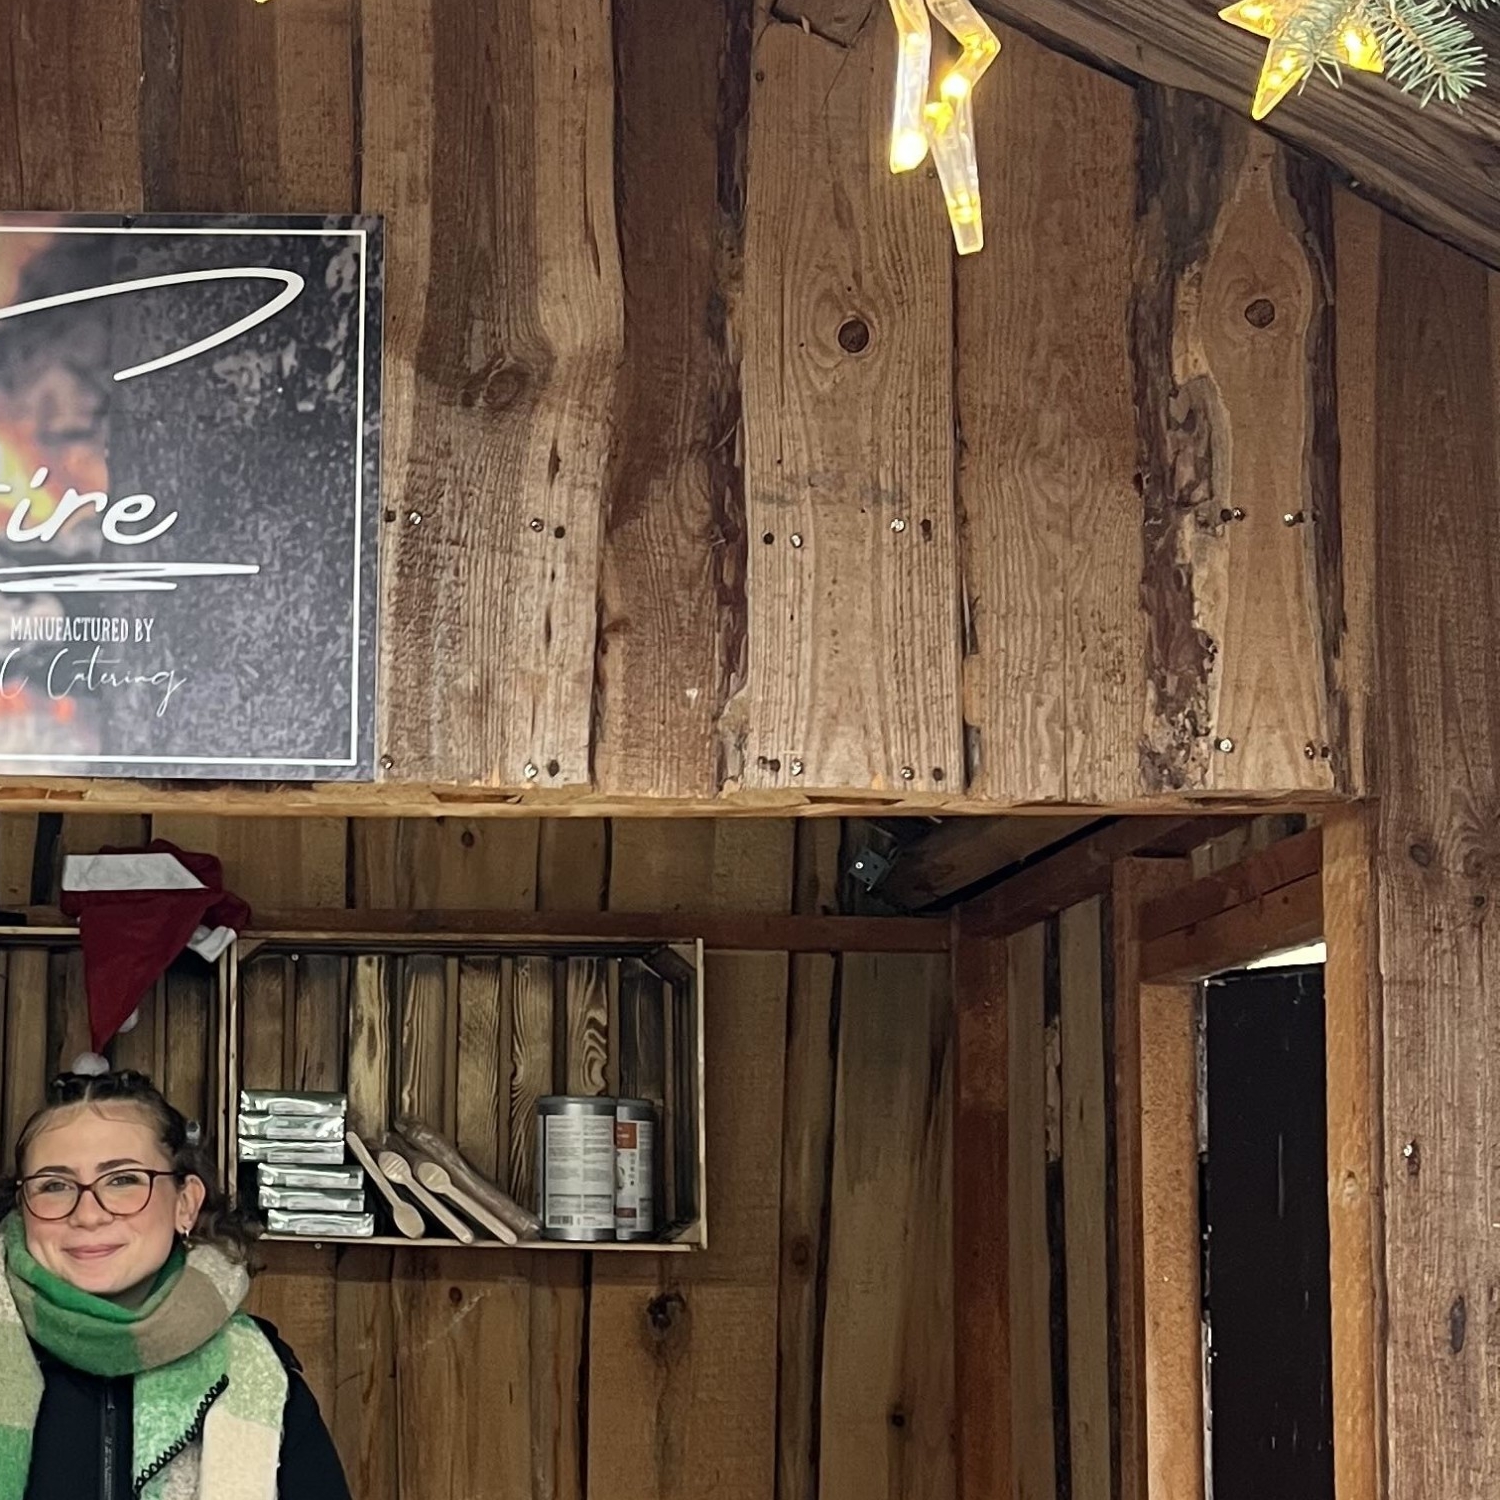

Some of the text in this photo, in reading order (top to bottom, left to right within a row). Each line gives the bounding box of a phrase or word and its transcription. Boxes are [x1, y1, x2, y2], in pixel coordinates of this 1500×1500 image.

[10, 616, 154, 643] MANUFACTURED BY
[47, 645, 188, 717] Catering
